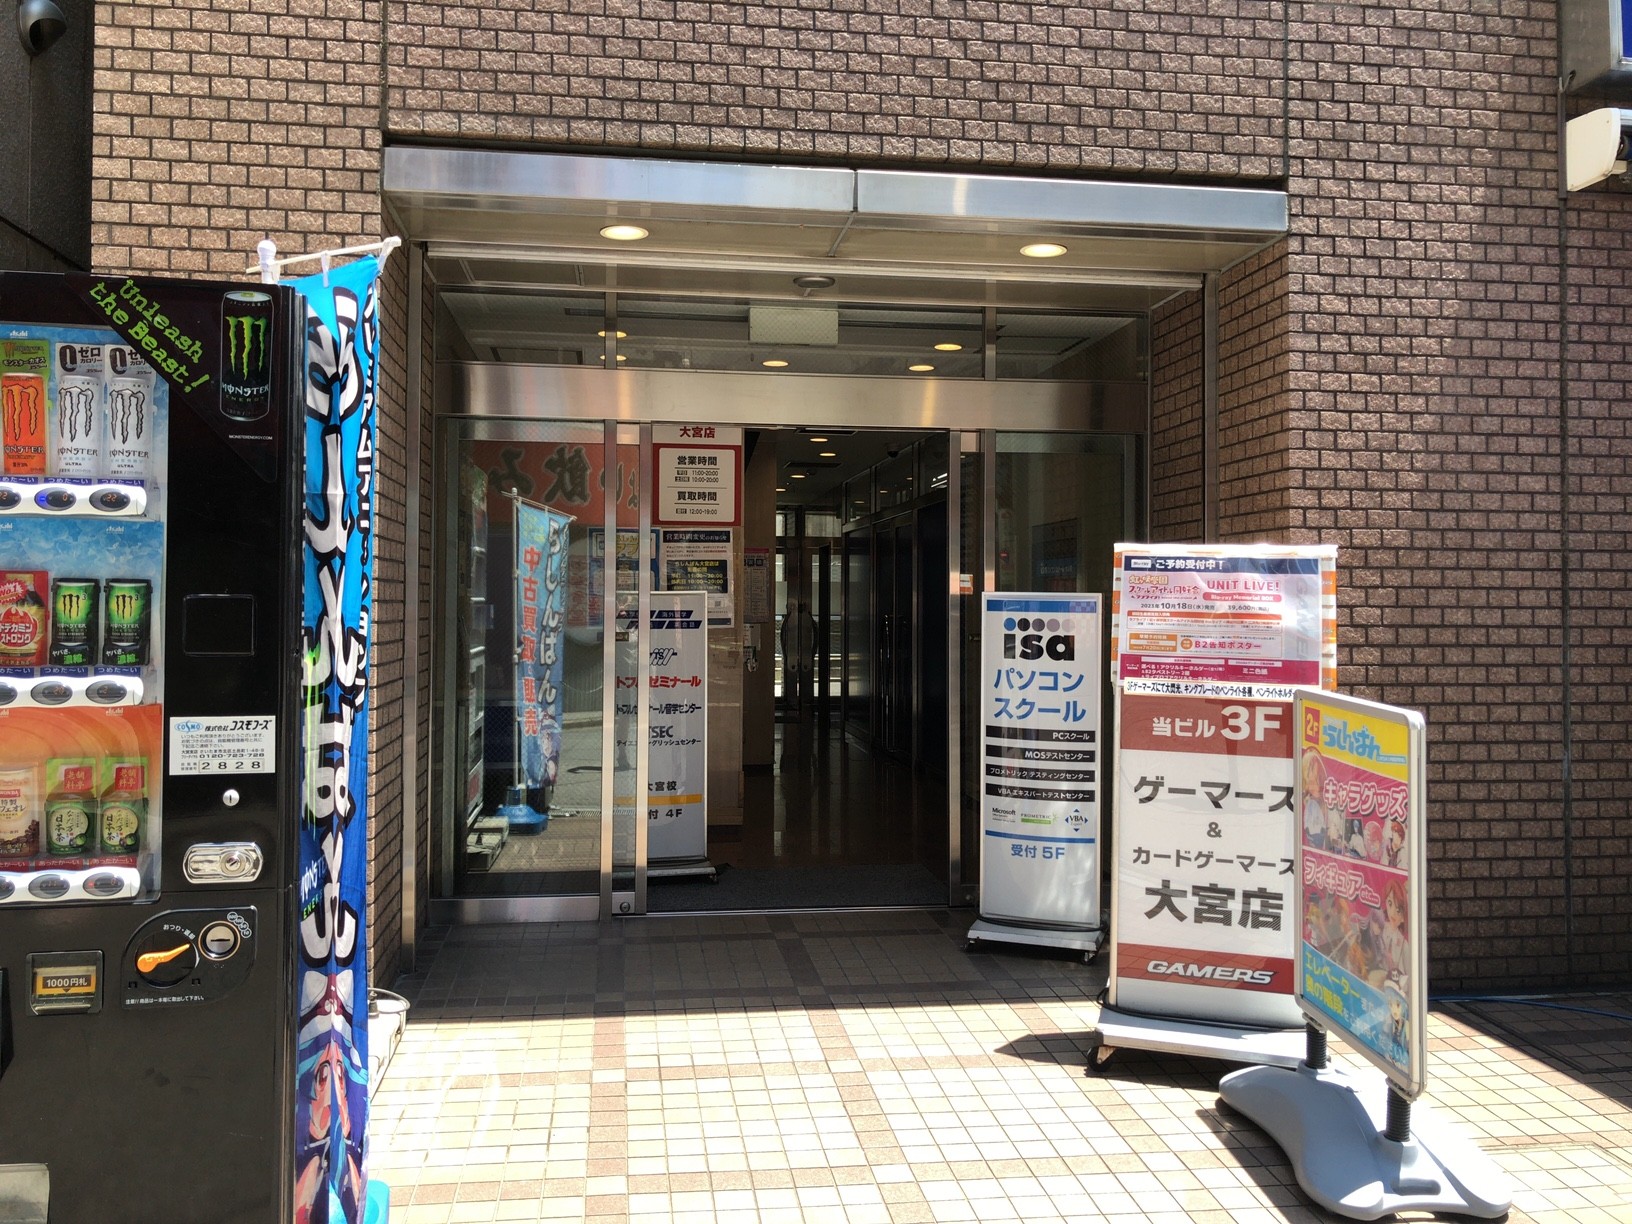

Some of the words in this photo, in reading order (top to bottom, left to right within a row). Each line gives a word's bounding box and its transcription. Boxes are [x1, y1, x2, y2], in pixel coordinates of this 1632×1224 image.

[119, 279, 203, 363] Unleash
[89, 282, 130, 325] the
[128, 320, 210, 393] Beast!
[59, 345, 77, 373] 0
[78, 347, 101, 358] ゼロ
[109, 347, 127, 375] 0
[222, 384, 269, 395] MONSTER
[680, 426, 716, 438] 大宮店
[677, 456, 717, 466] 営業時間
[677, 491, 717, 501] 買取時間
[1207, 580, 1238, 590] UNIT
[1244, 580, 1280, 592] LIVE!
[538, 518, 560, 704] らしんばん
[1, 634, 31, 643] ストロング
[1004, 625, 1075, 661] isa
[617, 675, 702, 688] トフゼミナール
[994, 667, 1084, 692] パソコン
[994, 698, 1087, 722] スクール
[177, 720, 201, 733] COSMO
[230, 720, 273, 731] コスモフーズ
[1152, 717, 1215, 738] 当ビル
[1221, 705, 1283, 742] 3F
[1306, 713, 1319, 737] 2F
[1025, 750, 1090, 760] MOSテストセンター
[990, 768, 1028, 776] プロメトリック
[1030, 771, 1090, 779] テスティングセンター
[1013, 790, 1090, 798] エキスパートテストセンター
[1323, 777, 1408, 821] キャラグッズ
[666, 808, 682, 818] 4F
[55, 814, 65, 842] 日本茶
[105, 814, 116, 842] 日本茶
[1207, 821, 1222, 838] &
[1011, 844, 1037, 858] 受付
[1042, 847, 1065, 859] 5F
[1304, 856, 1364, 900] フィギュア
[1144, 879, 1284, 932] 大宮店
[46, 978, 88, 987] 1000円札
[1147, 960, 1275, 985] GAMERS
